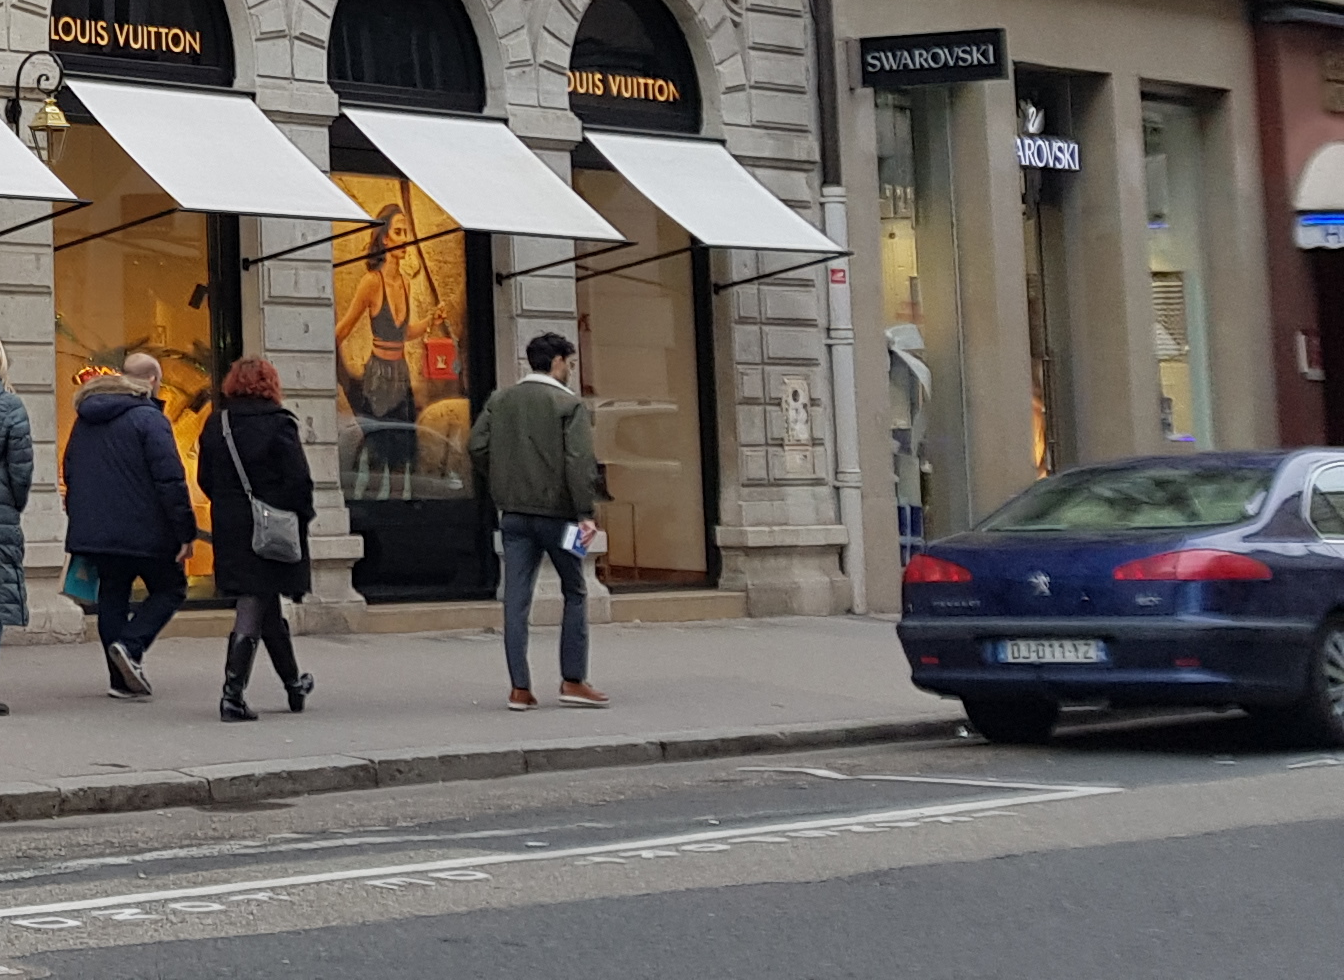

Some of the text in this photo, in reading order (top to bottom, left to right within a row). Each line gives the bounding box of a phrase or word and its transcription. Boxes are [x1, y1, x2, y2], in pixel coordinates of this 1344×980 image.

[50, 15, 202, 55] LOUIS VUITTON
[866, 43, 997, 73] SWAROVSKI
[567, 70, 604, 97] OUIS
[1016, 136, 1080, 170] AROVSKI
